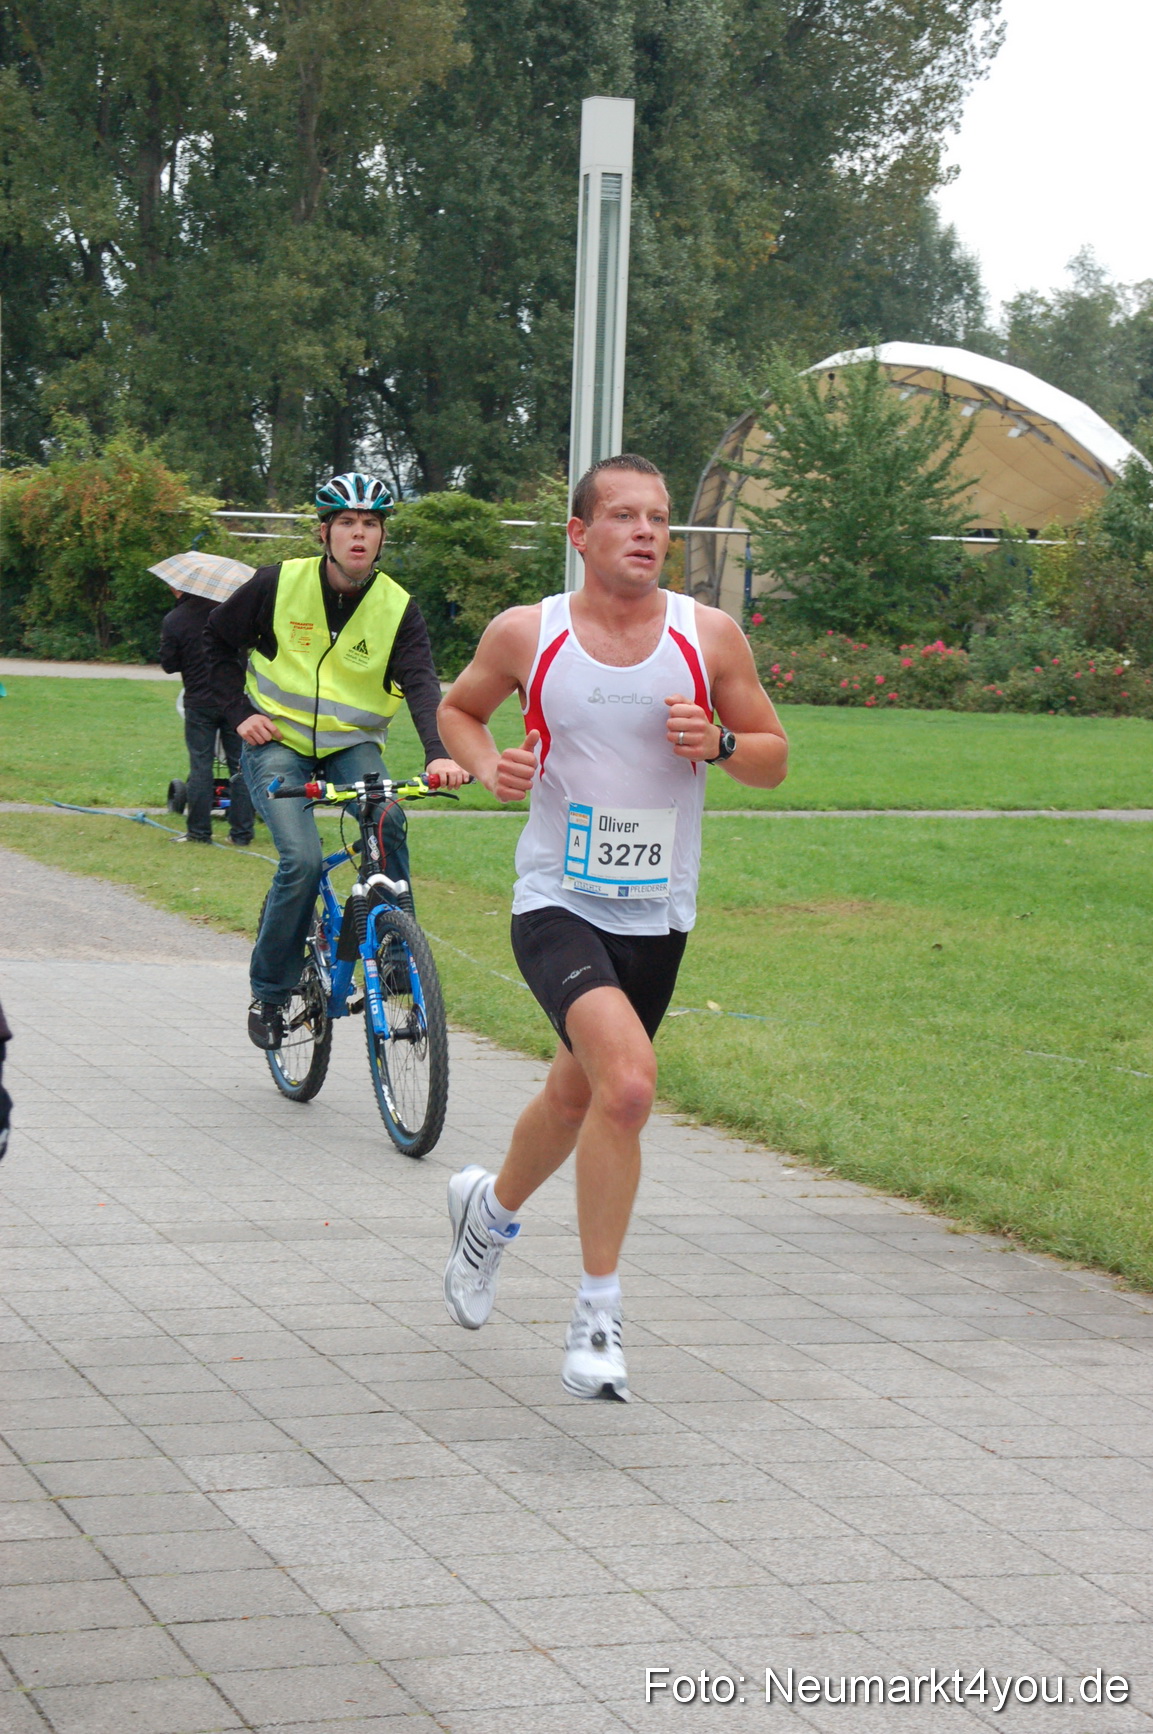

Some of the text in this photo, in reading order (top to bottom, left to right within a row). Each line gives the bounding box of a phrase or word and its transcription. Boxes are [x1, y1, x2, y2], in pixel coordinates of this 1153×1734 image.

[608, 693, 653, 705] odlo
[598, 815, 640, 833] Oliver
[573, 835, 580, 847] A
[598, 842, 662, 867] 3278
[630, 884, 668, 893] PFLEIDERER
